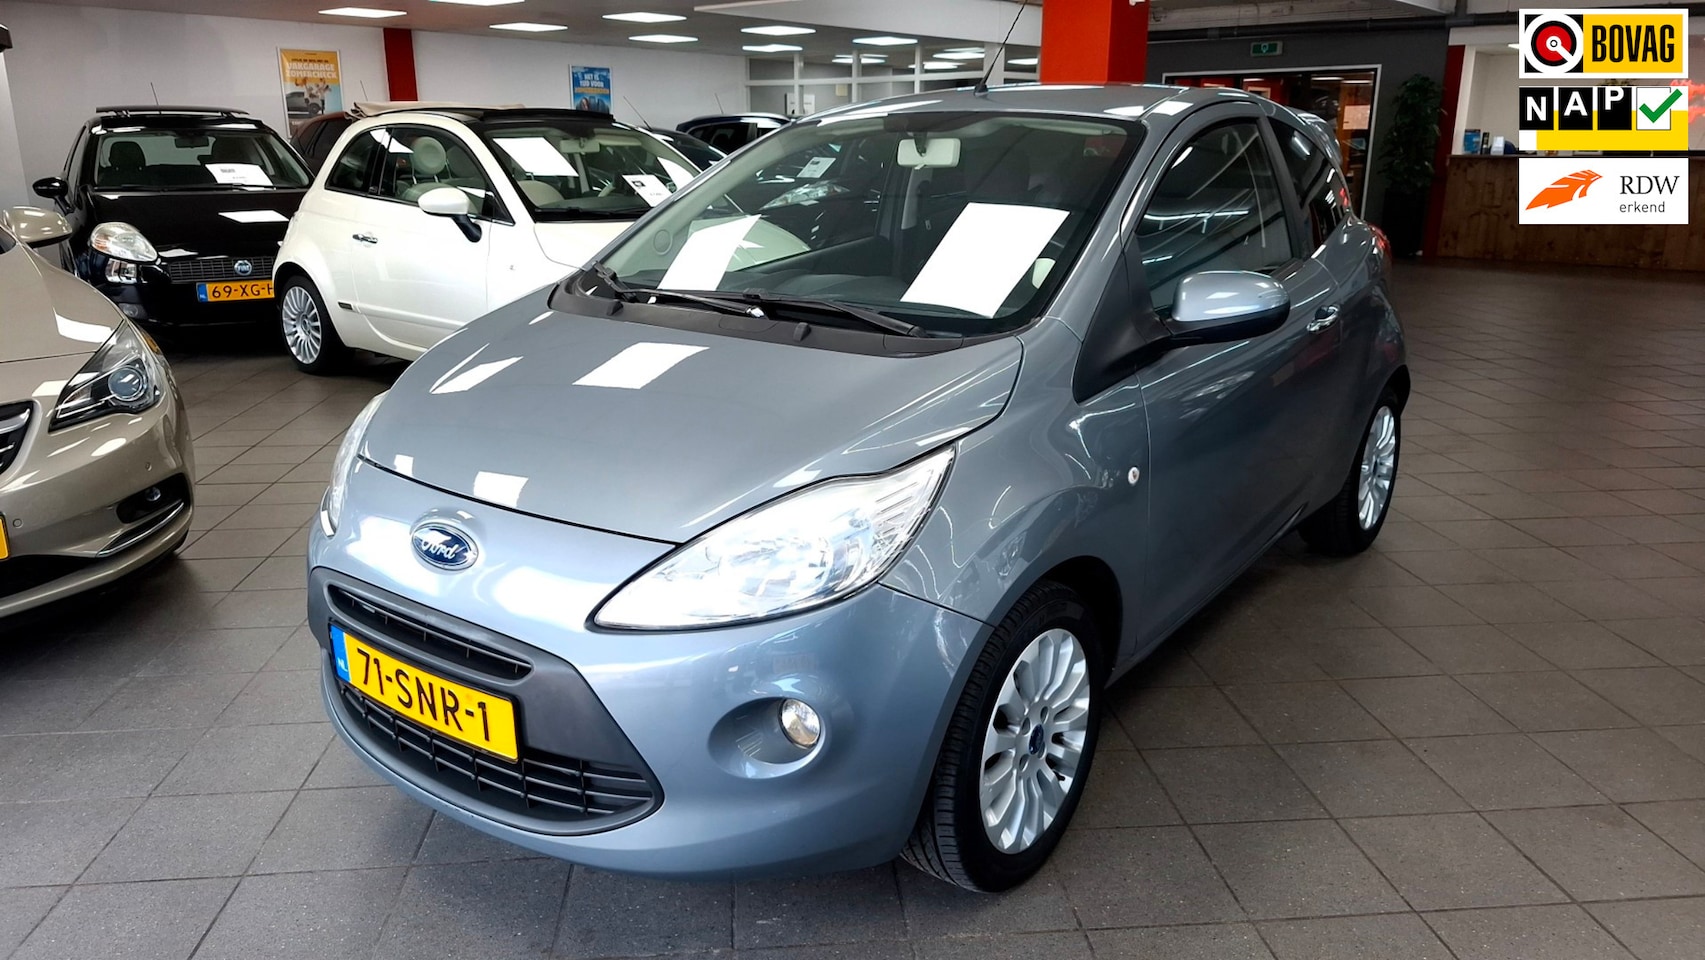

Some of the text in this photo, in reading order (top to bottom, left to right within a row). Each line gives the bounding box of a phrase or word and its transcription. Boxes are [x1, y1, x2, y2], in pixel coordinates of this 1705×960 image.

[420, 530, 459, 560] Ford
[337, 647, 490, 742] NL 71-SNR-1
